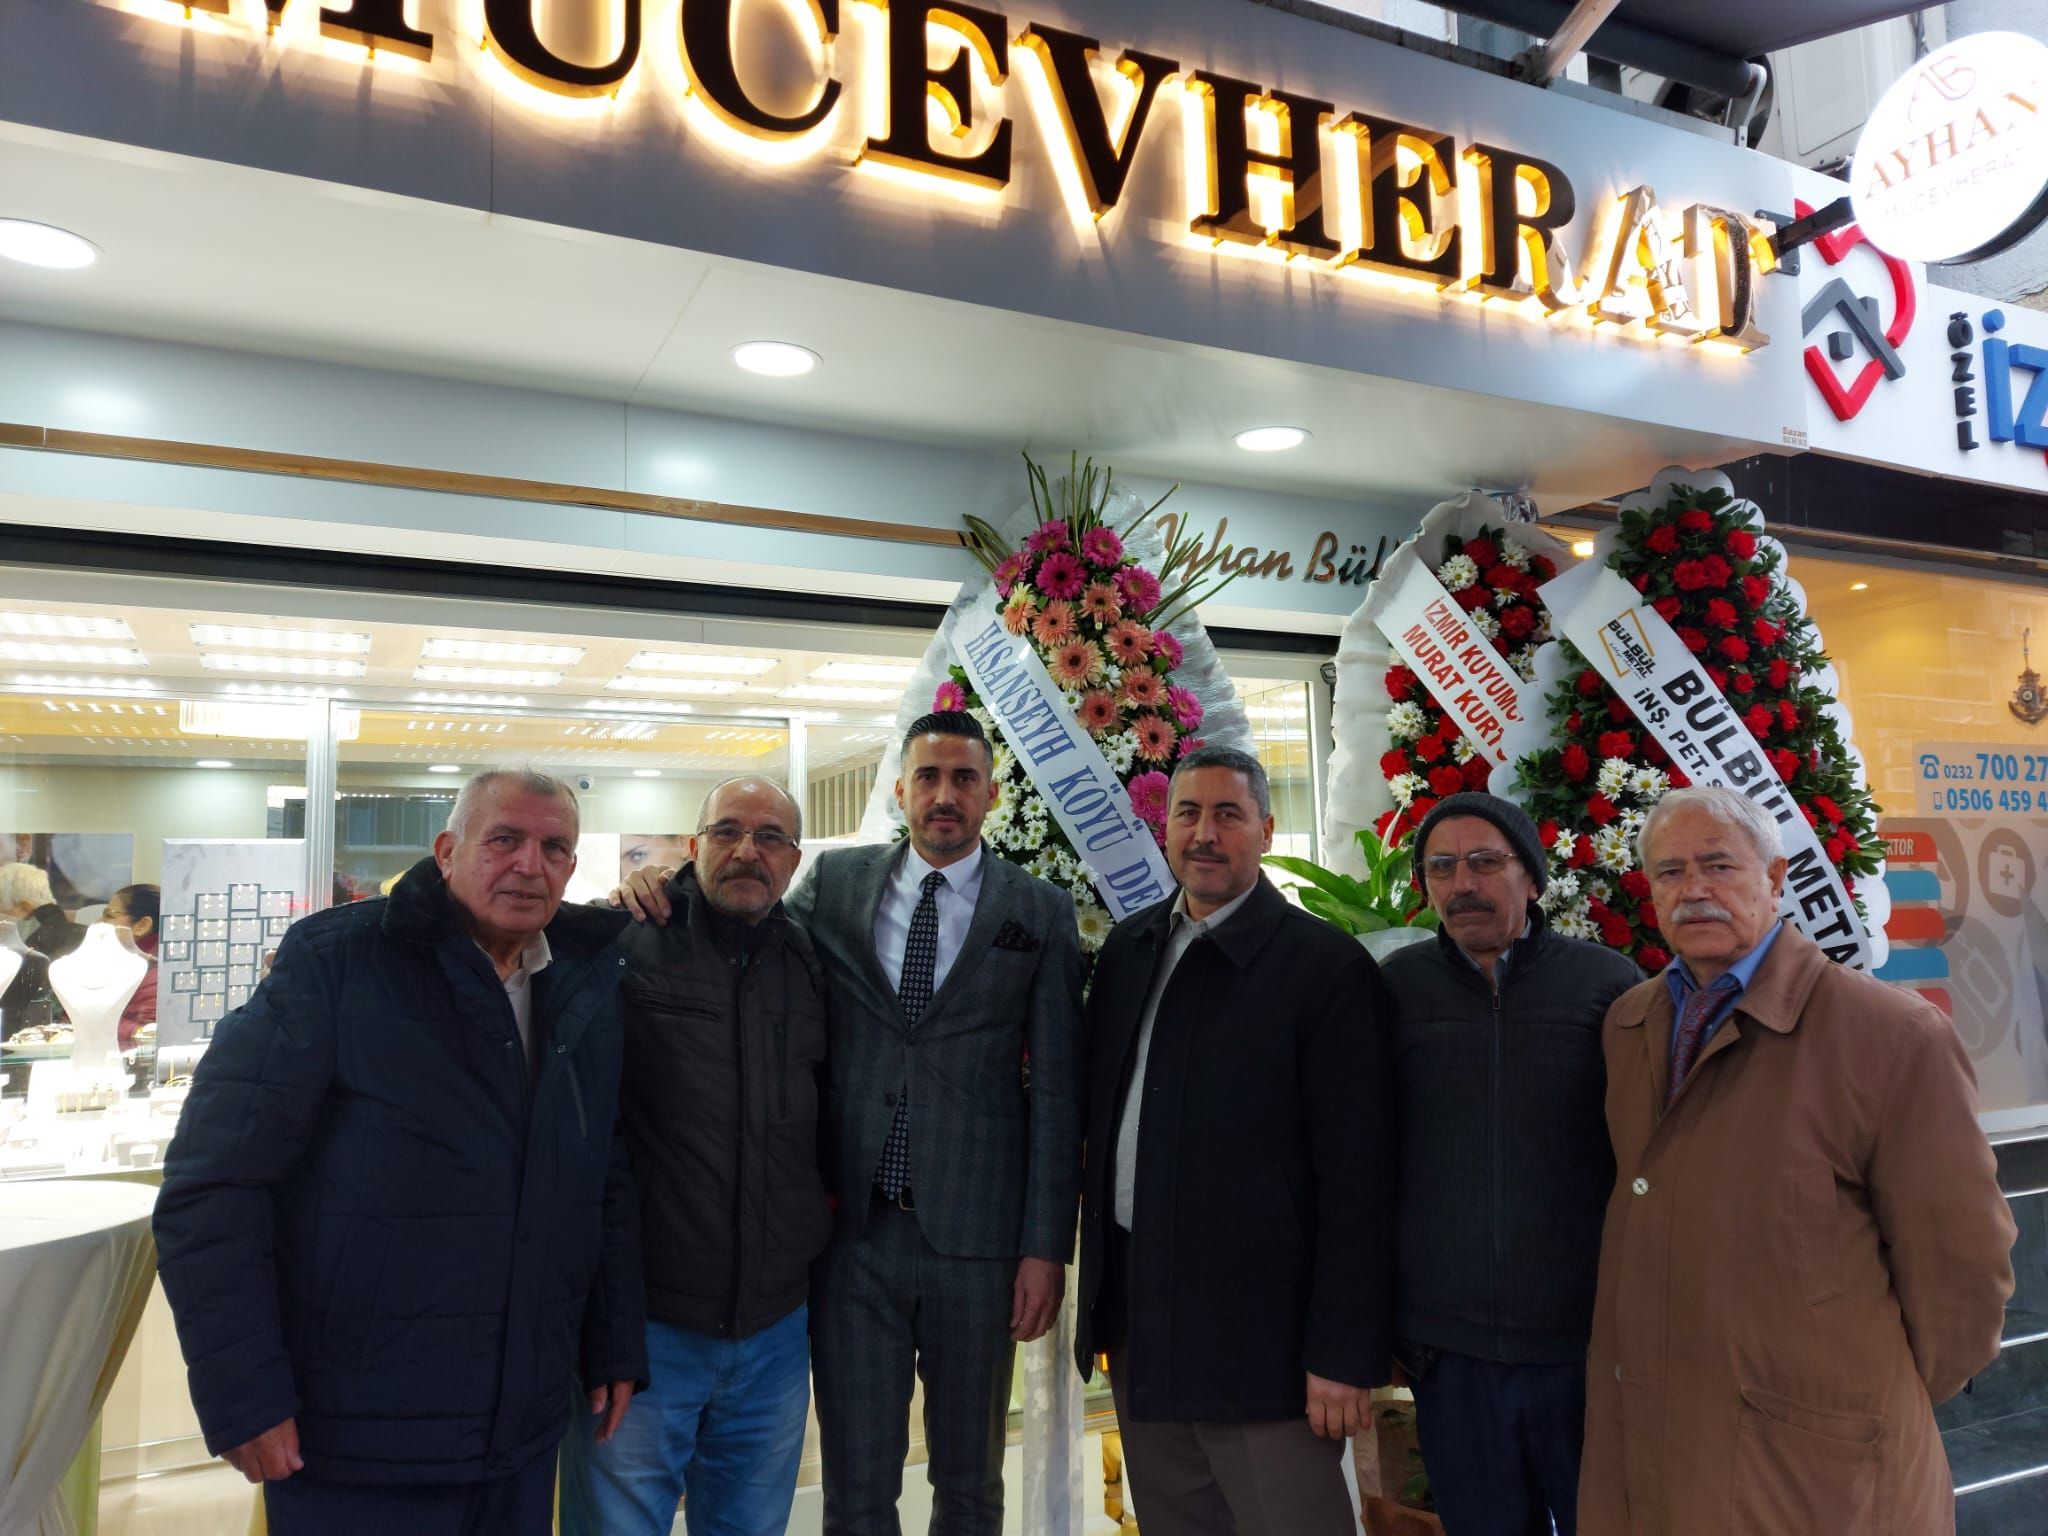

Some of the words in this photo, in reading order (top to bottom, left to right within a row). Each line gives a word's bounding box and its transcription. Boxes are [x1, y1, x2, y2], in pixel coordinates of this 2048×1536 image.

[1303, 531, 1401, 585] Bül
[1402, 623, 1466, 691] MURAT
[1622, 650, 1649, 679] METAL
[1668, 729, 1710, 777] PET.
[1943, 764, 1974, 780] 0232
[1976, 753, 2019, 781] 700
[1048, 765, 1144, 853] KÖYÜ
[1946, 787, 1994, 812] 0506
[1998, 789, 2032, 812] 459
[1787, 847, 1864, 971] META
